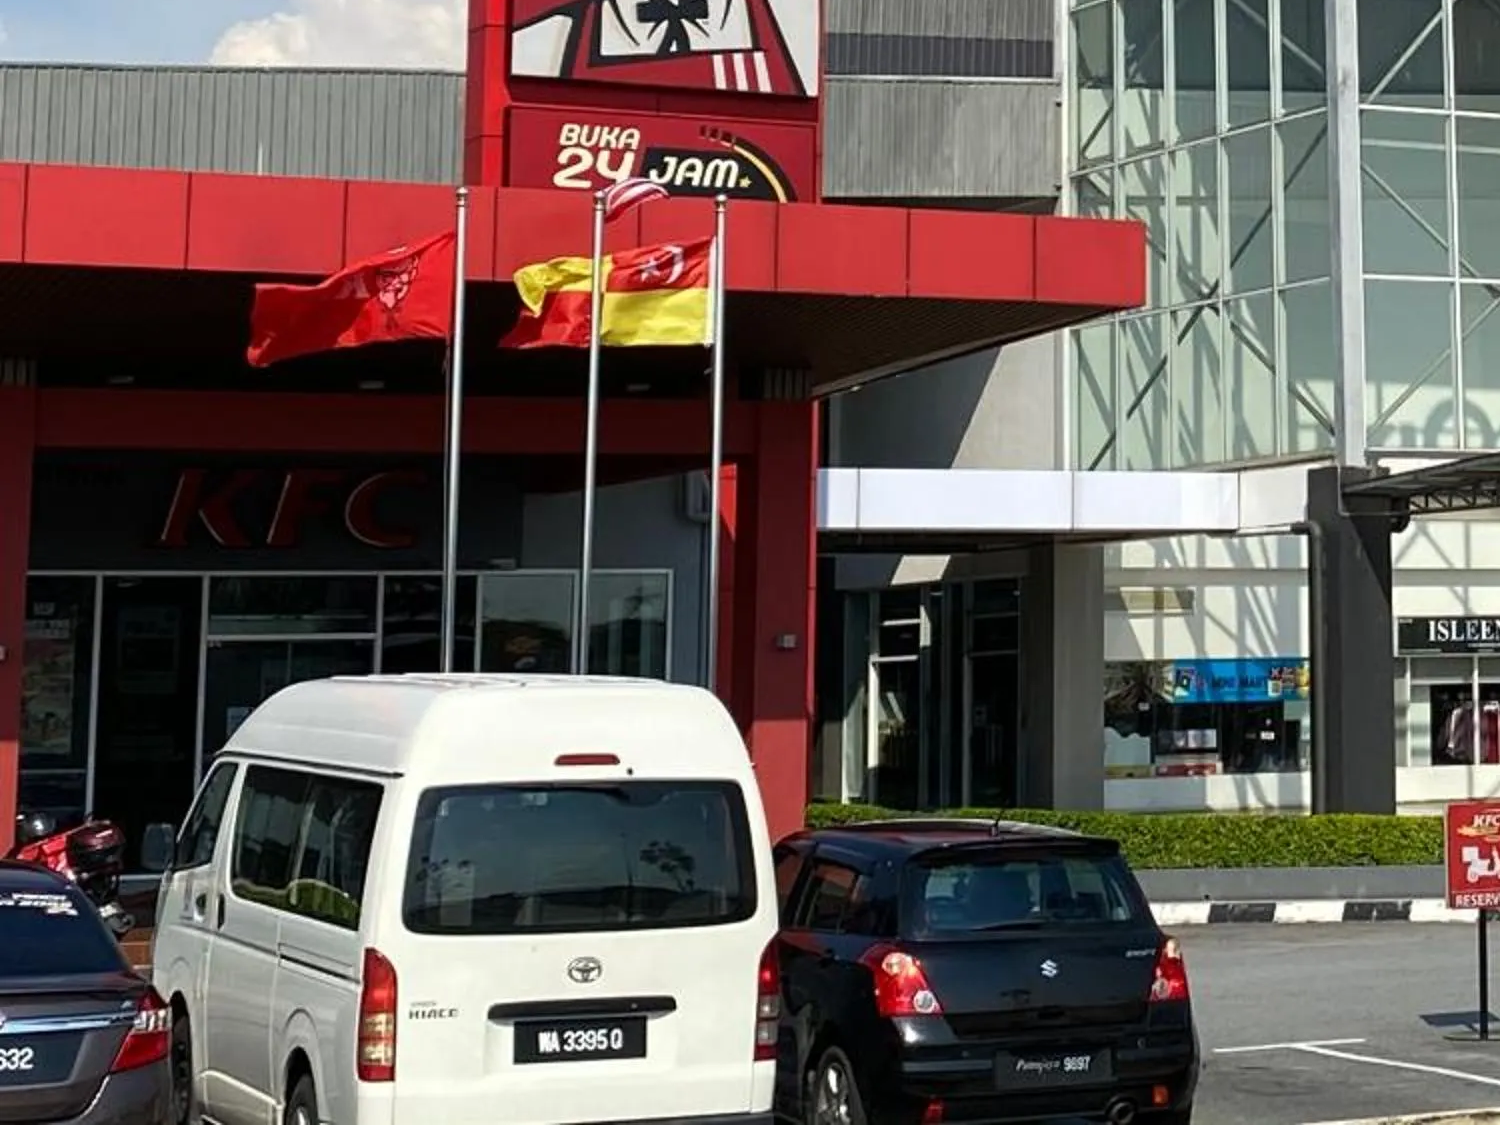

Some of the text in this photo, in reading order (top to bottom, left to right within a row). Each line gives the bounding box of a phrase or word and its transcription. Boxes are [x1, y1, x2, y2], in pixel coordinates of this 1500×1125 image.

[559, 123, 641, 150] BUKA
[553, 146, 740, 189] 24 JAM
[156, 466, 430, 549] KFC
[538, 1030, 560, 1053] WA
[562, 1029, 609, 1053] 3395
